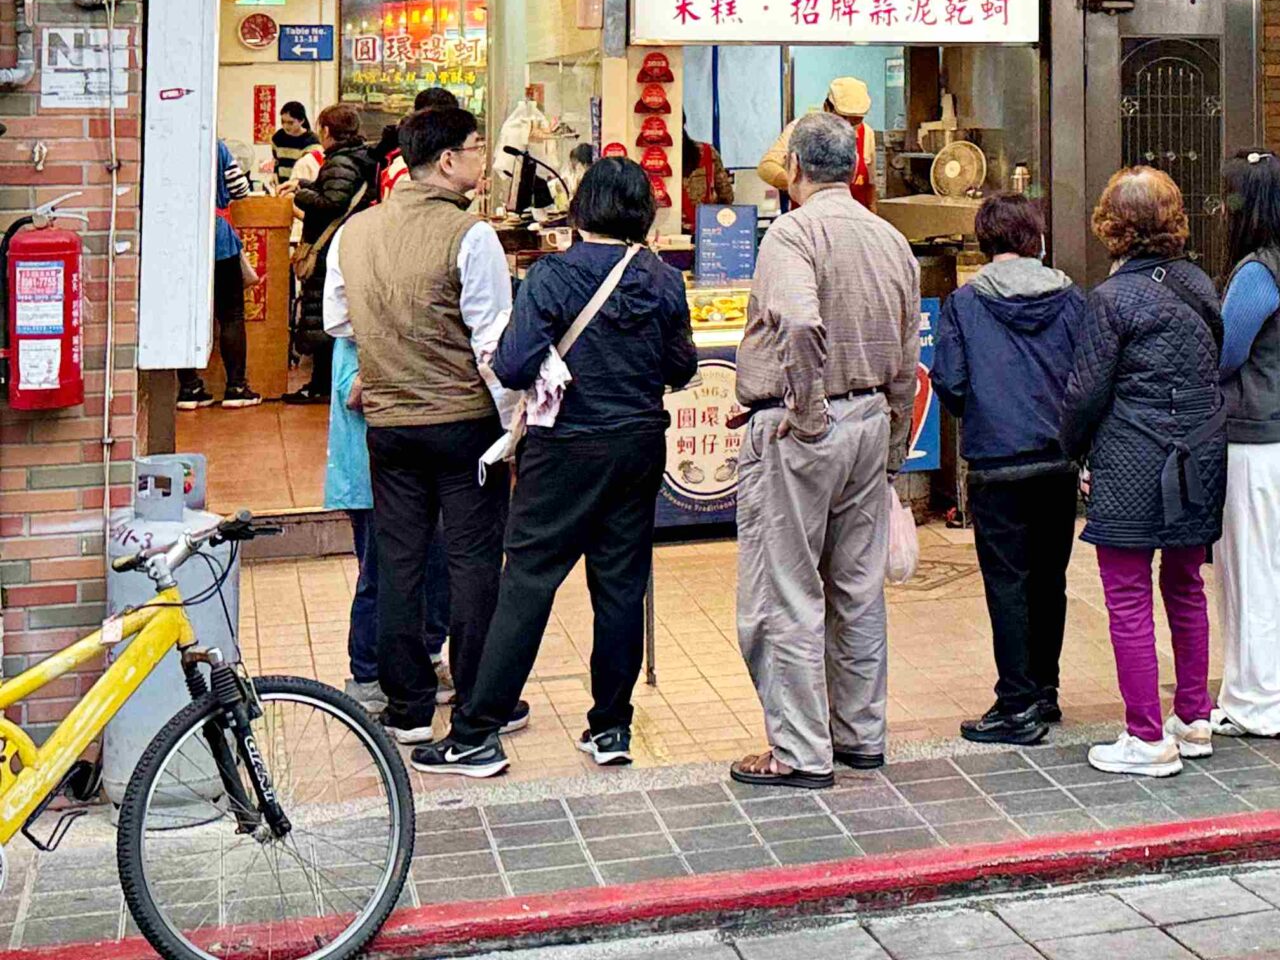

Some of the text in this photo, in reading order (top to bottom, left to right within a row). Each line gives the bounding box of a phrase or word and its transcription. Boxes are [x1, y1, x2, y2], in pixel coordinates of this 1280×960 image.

[286, 27, 309, 35] Table
[677, 433, 742, 456] 蚵仔煎
